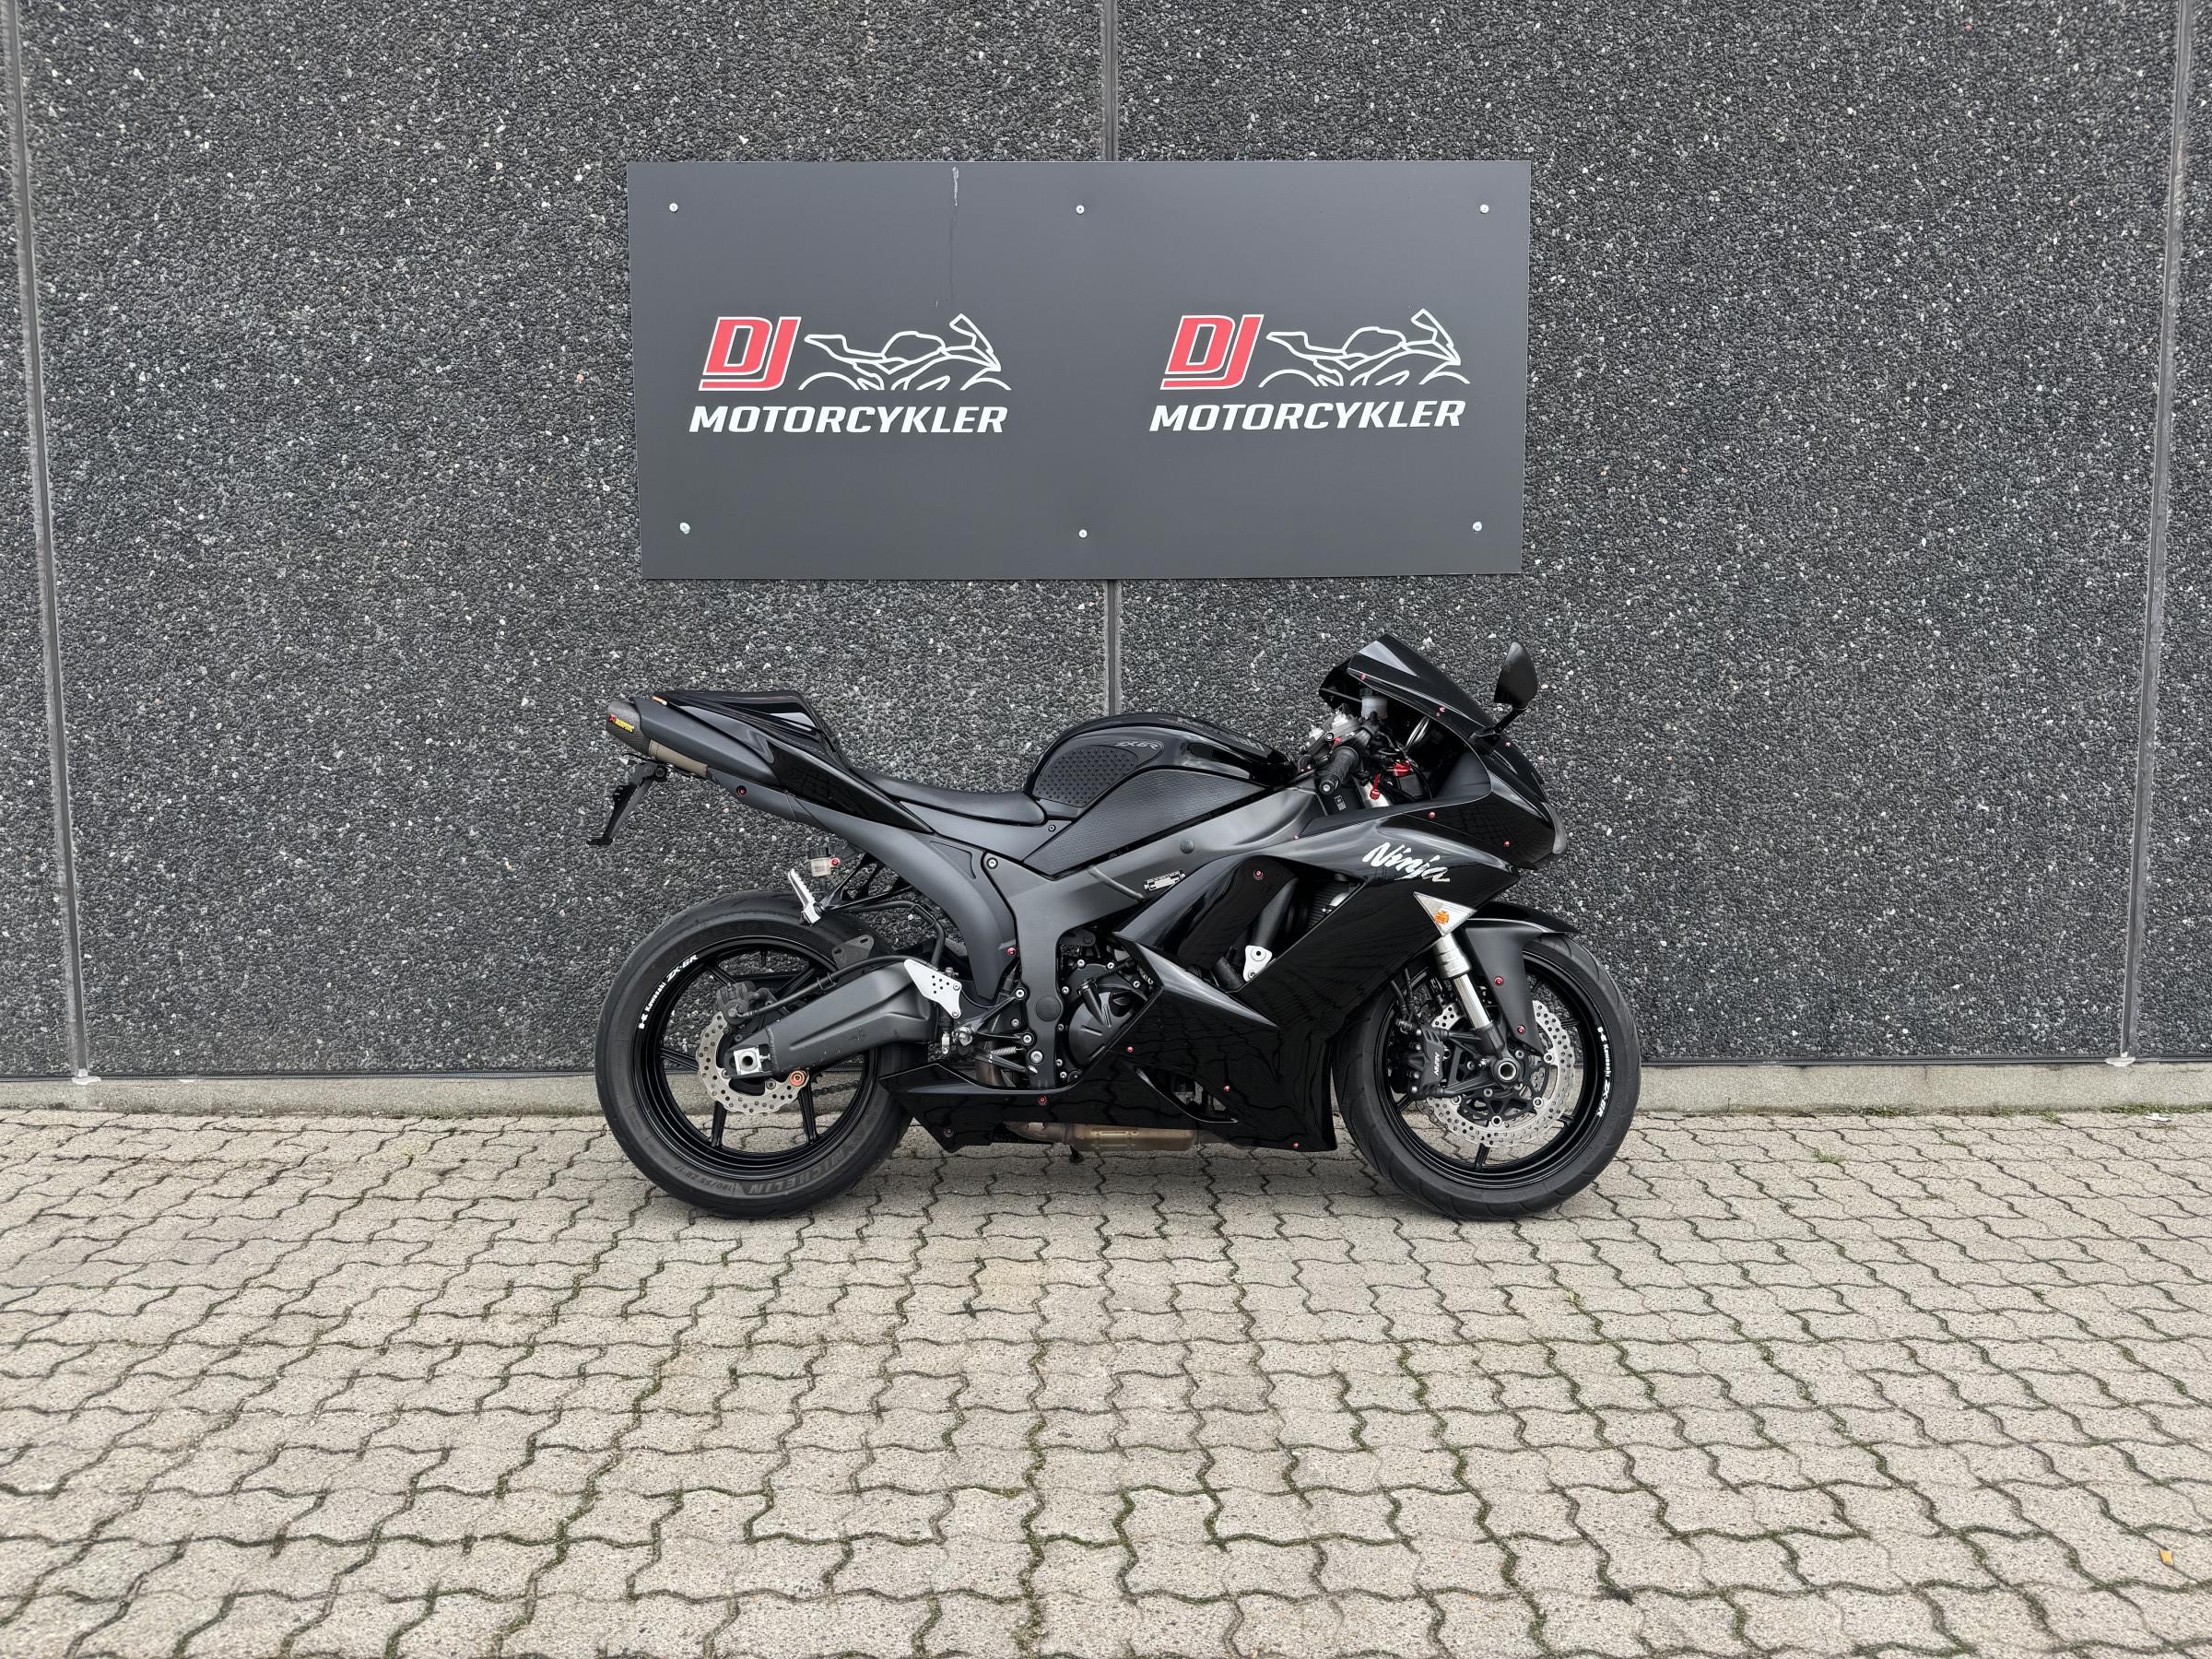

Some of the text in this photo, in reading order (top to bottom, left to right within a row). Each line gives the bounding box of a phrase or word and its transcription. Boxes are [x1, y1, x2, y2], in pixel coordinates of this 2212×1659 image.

[699, 316, 802, 392] DJ
[1159, 313, 1265, 390] DJ
[688, 406, 1008, 433] MOTORCYKLER
[1148, 400, 1466, 431] MOTORCYKLER
[1362, 841, 1451, 882] Ninja
[747, 1149, 846, 1196] MICHELIN
